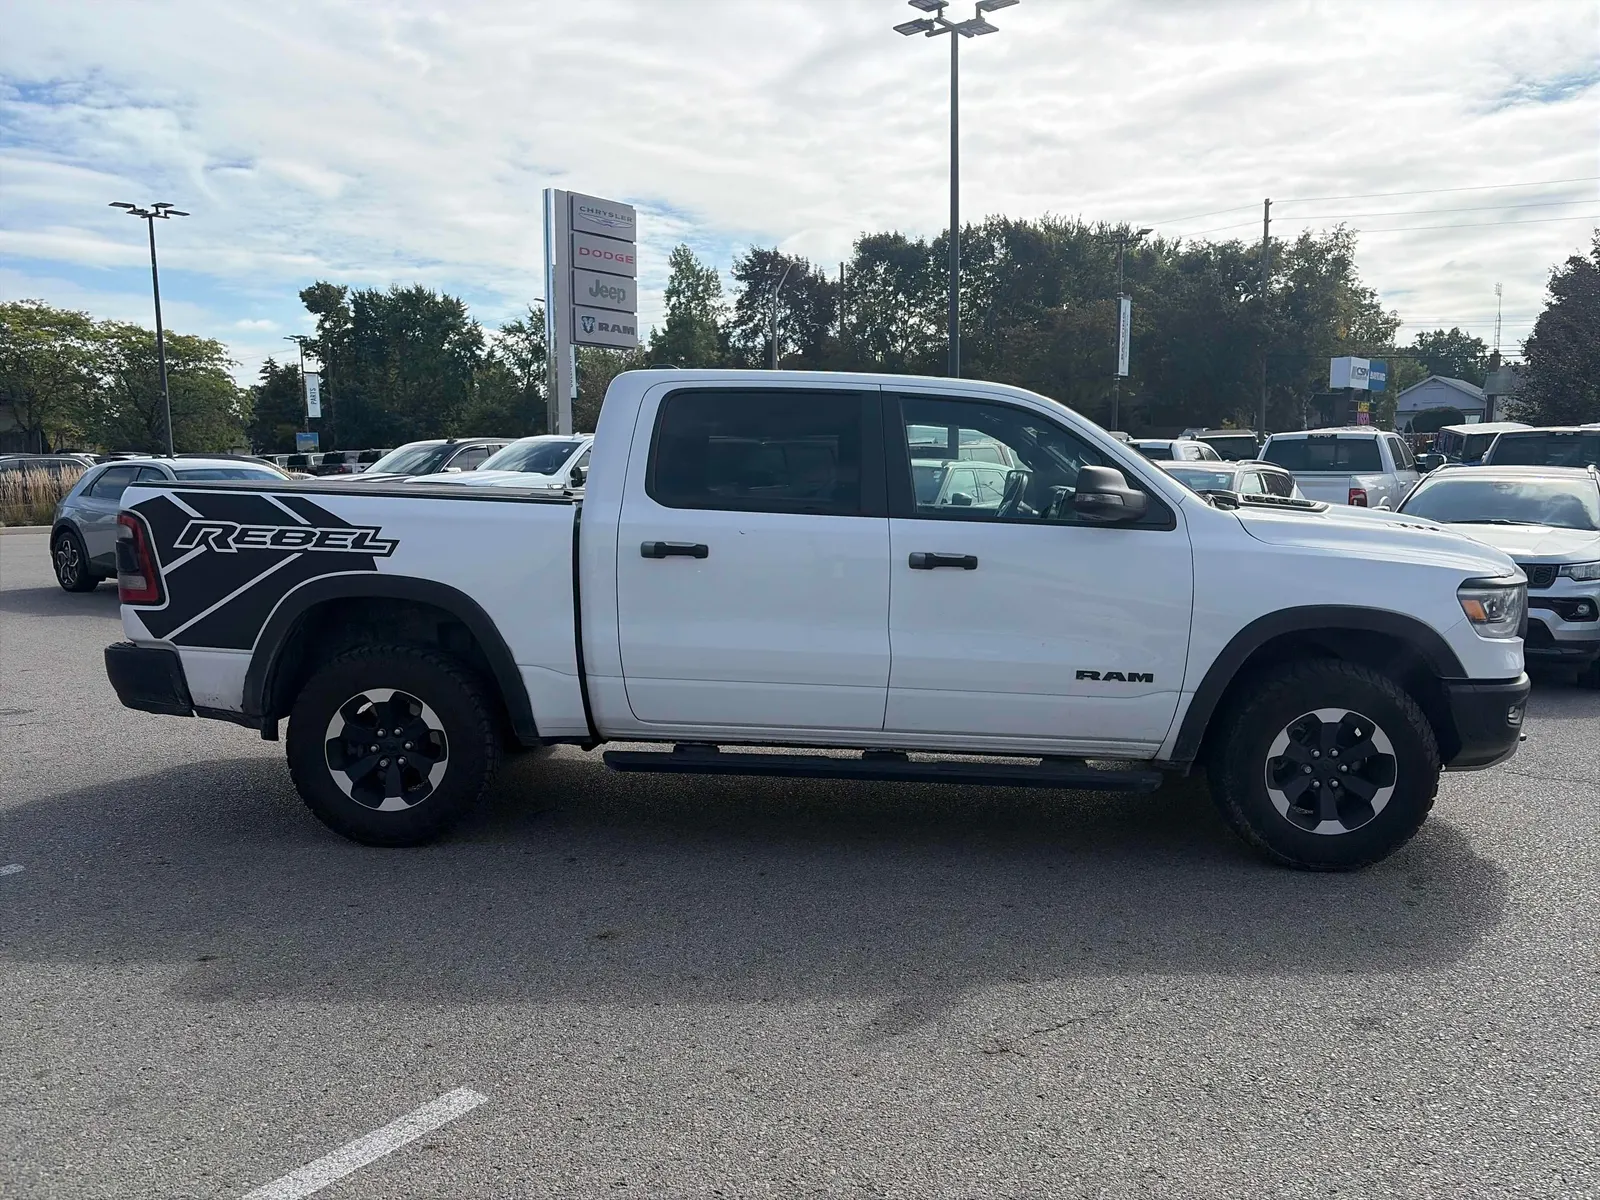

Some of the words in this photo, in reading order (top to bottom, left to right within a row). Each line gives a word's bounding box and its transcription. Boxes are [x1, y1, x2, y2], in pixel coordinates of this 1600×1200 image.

[579, 205, 633, 223] CHRYSLER
[578, 246, 634, 264] DODGE
[589, 279, 626, 304] Jeep
[598, 322, 635, 336] RAM
[173, 519, 400, 557] REBEL
[1075, 670, 1154, 683] RAM
